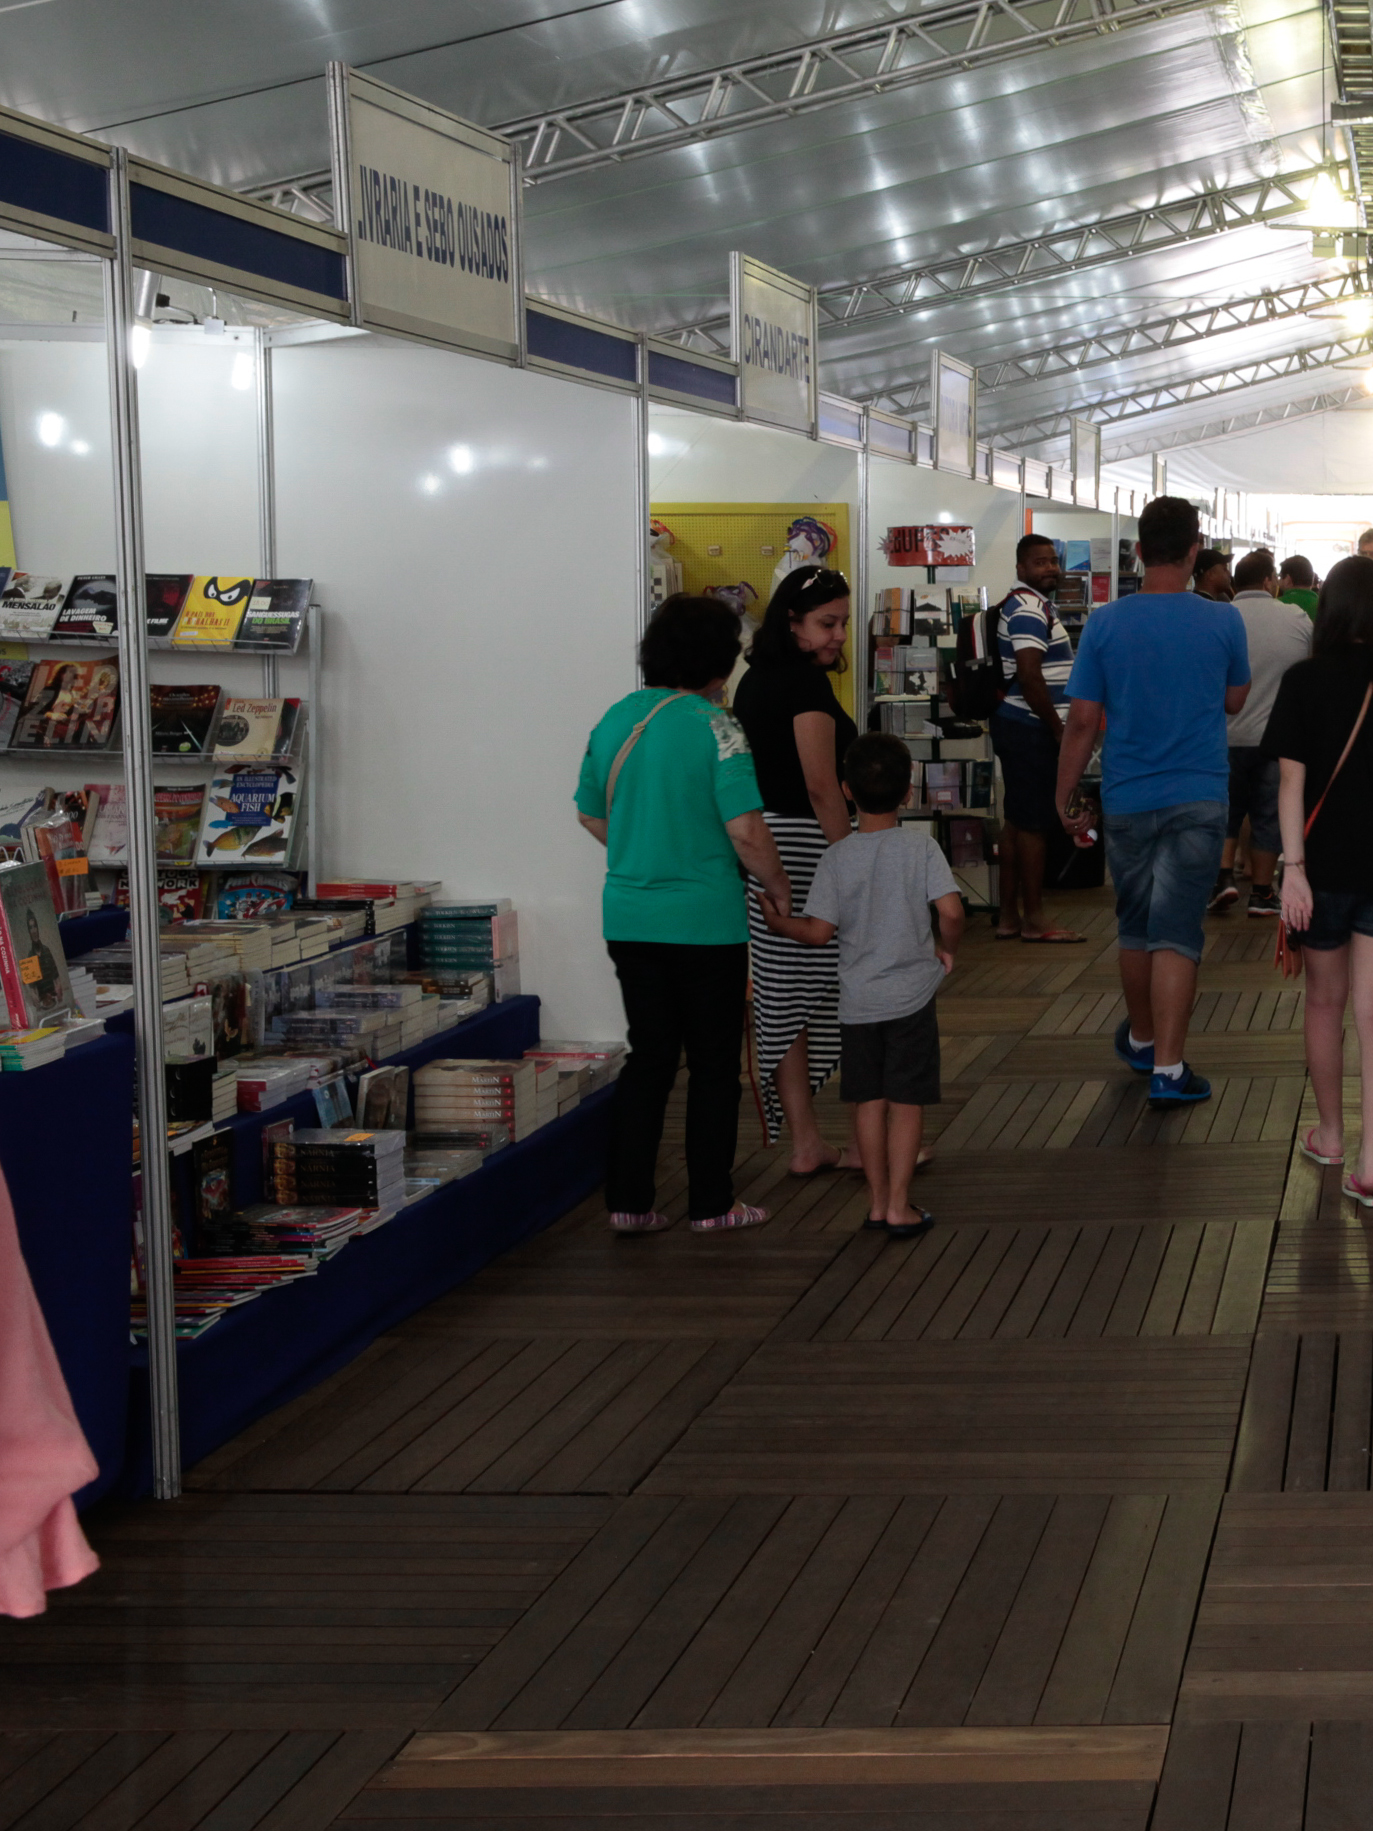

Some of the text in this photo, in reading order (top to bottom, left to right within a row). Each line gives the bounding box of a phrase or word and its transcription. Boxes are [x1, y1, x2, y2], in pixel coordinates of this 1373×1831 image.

[413, 184, 423, 258] E
[424, 188, 455, 268] SEBO
[744, 313, 810, 384] CIRANDARTE
[62, 608, 97, 616] LAVAGEM
[70, 614, 107, 622] DINHEIRO
[232, 703, 277, 715] Led Zeppelin
[231, 793, 275, 803] AQUARIUM
[241, 803, 261, 812] FISH
